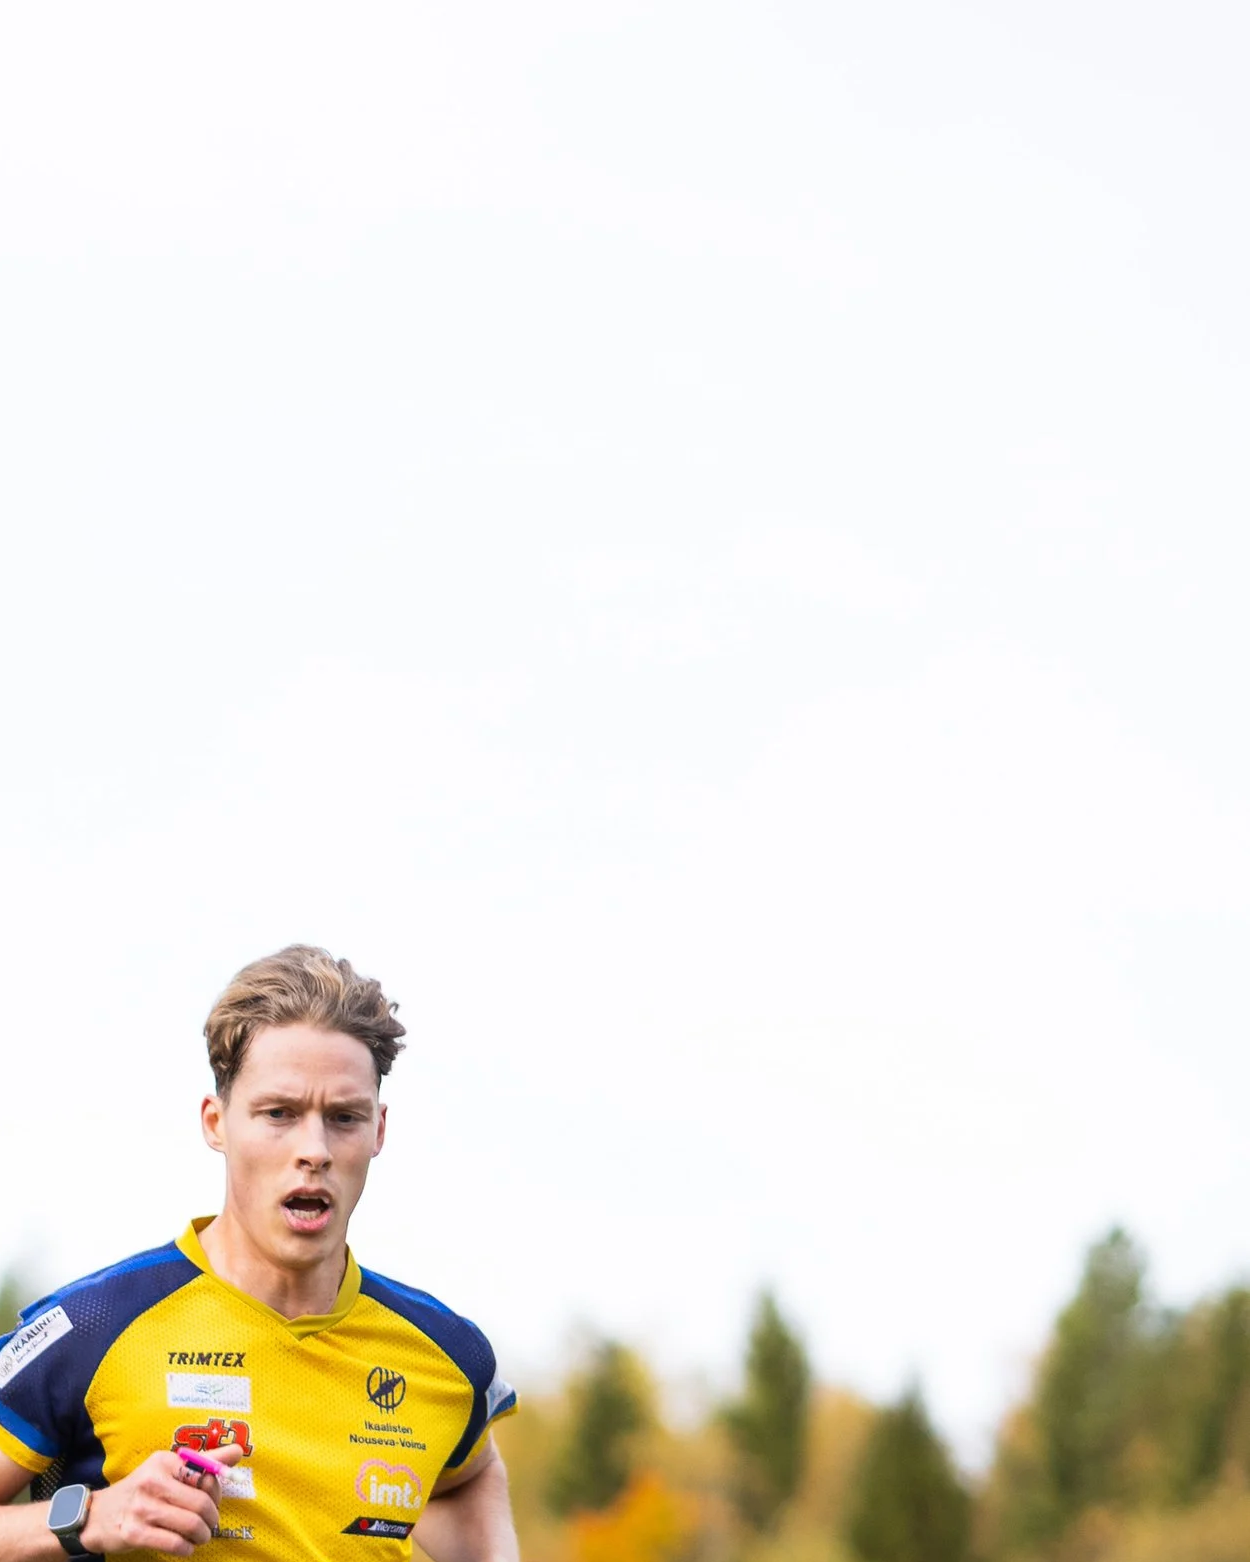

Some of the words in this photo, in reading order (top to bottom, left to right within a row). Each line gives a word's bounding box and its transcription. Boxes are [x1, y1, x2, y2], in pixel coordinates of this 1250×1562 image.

[167, 1352, 247, 1368] TRIMTEX
[364, 1420, 413, 1435] Ikaalisten
[349, 1433, 427, 1451] Nouseva-Voima
